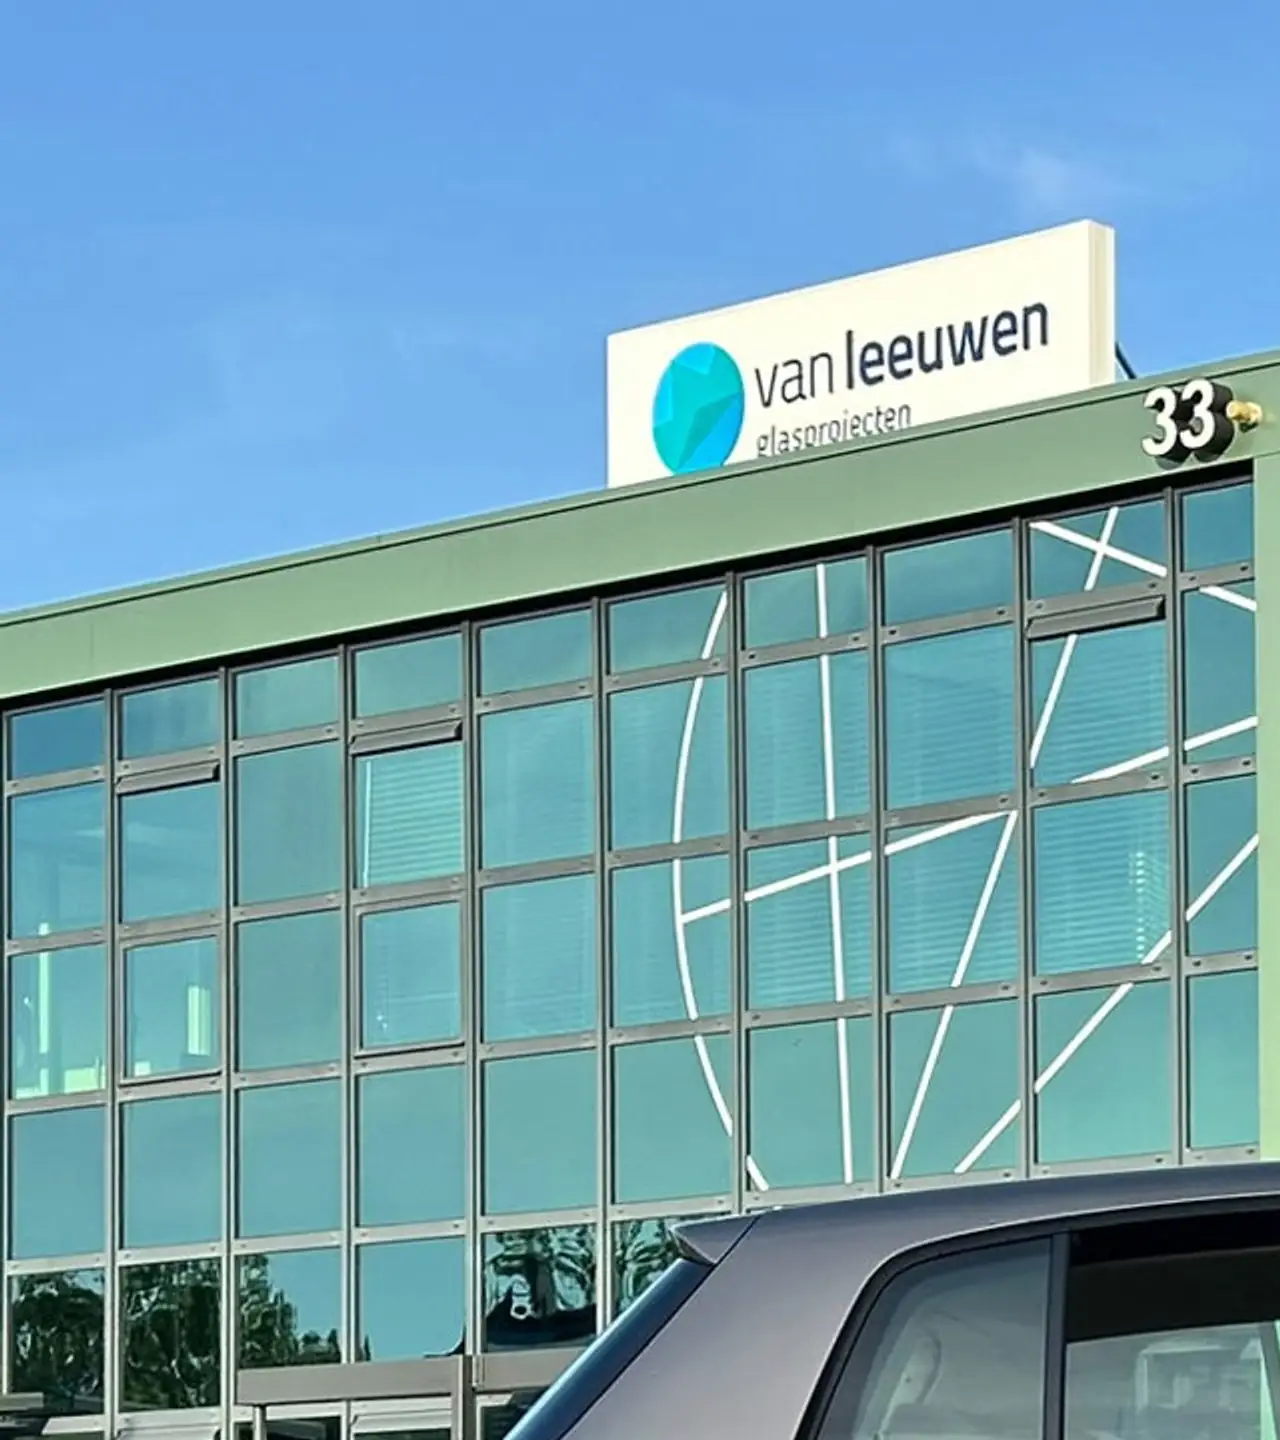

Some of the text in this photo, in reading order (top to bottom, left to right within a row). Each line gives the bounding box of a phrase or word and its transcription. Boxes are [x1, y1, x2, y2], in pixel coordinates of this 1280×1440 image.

[754, 302, 1048, 408] van leeuwen
[1142, 379, 1215, 456] 33
